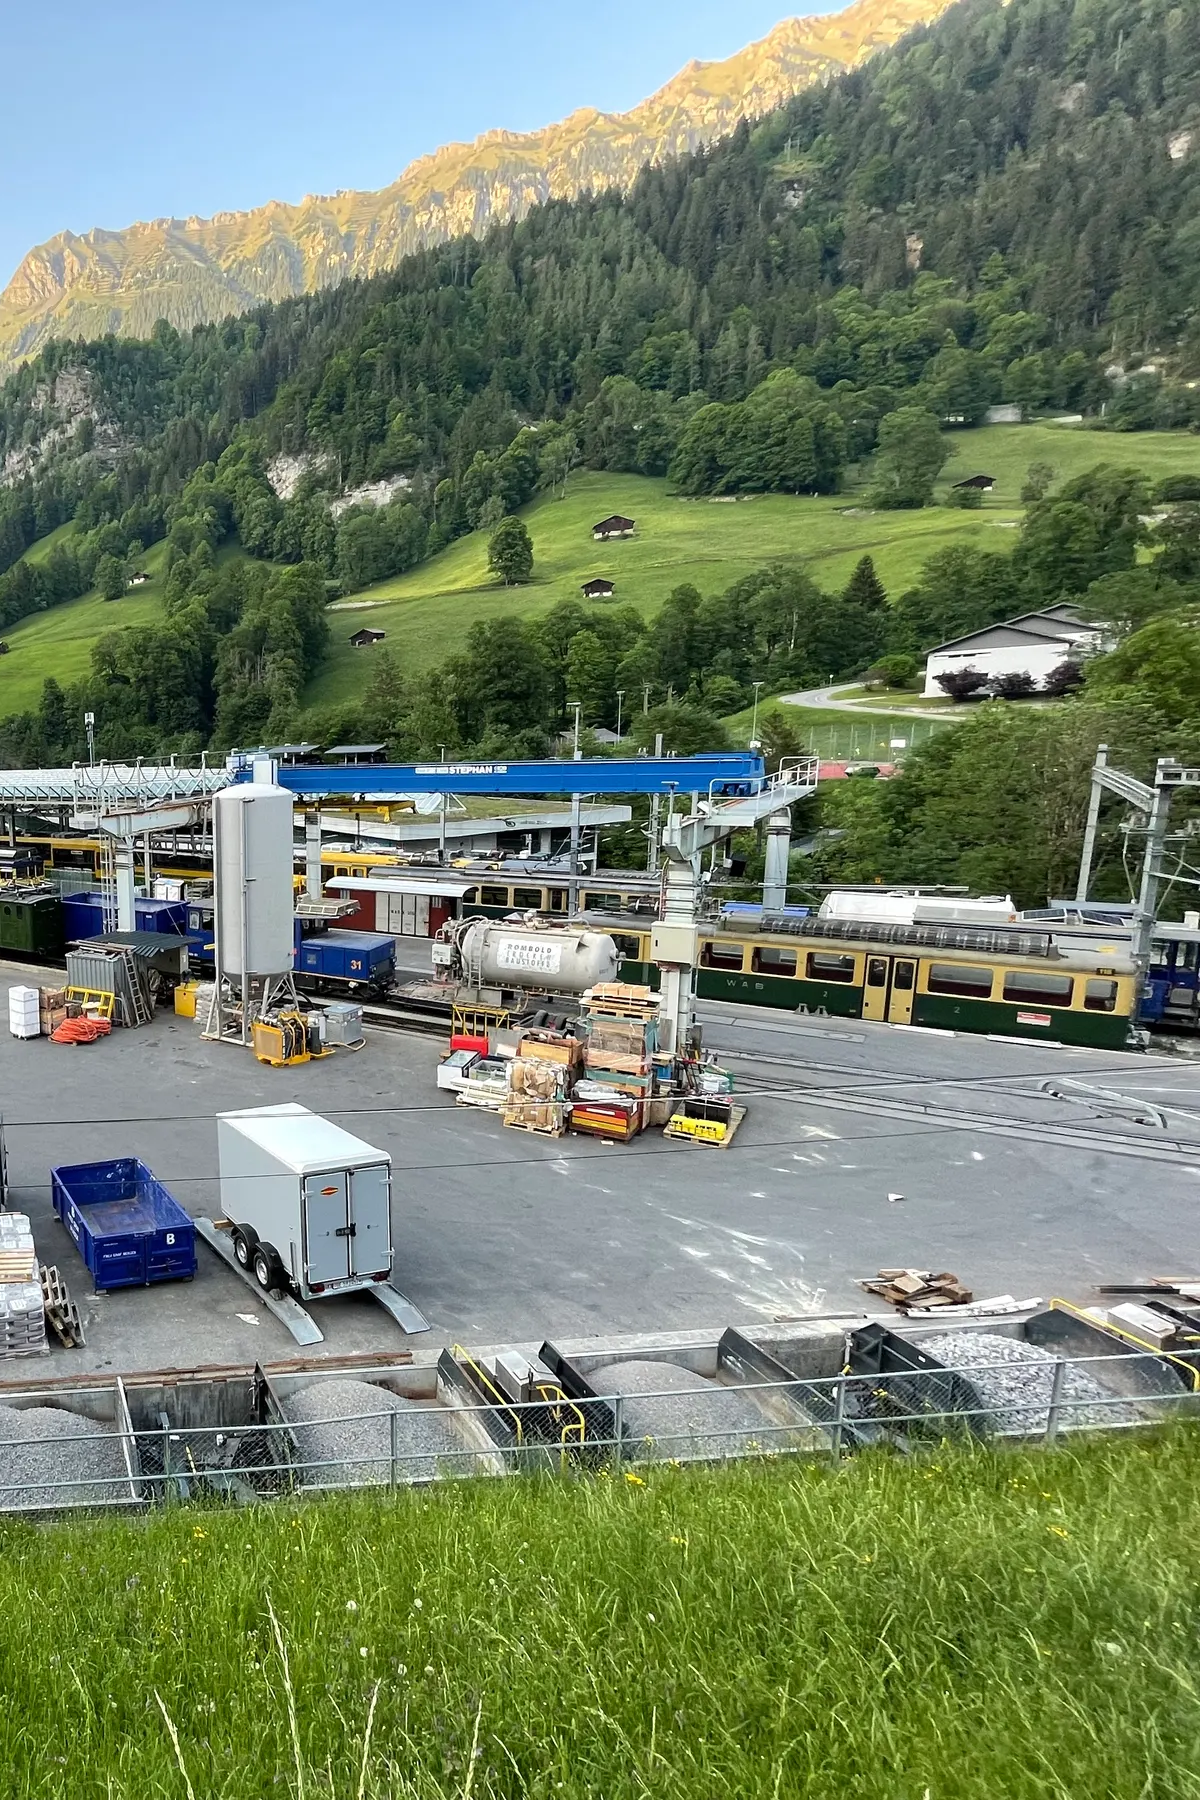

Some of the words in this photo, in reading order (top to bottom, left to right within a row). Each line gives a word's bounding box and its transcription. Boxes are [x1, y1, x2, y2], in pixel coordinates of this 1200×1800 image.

[449, 765, 493, 774] STEPHAN
[507, 943, 552, 954] ROMBOLD
[350, 959, 362, 971] 31
[954, 1006, 961, 1014] 2
[166, 1233, 176, 1246] B
